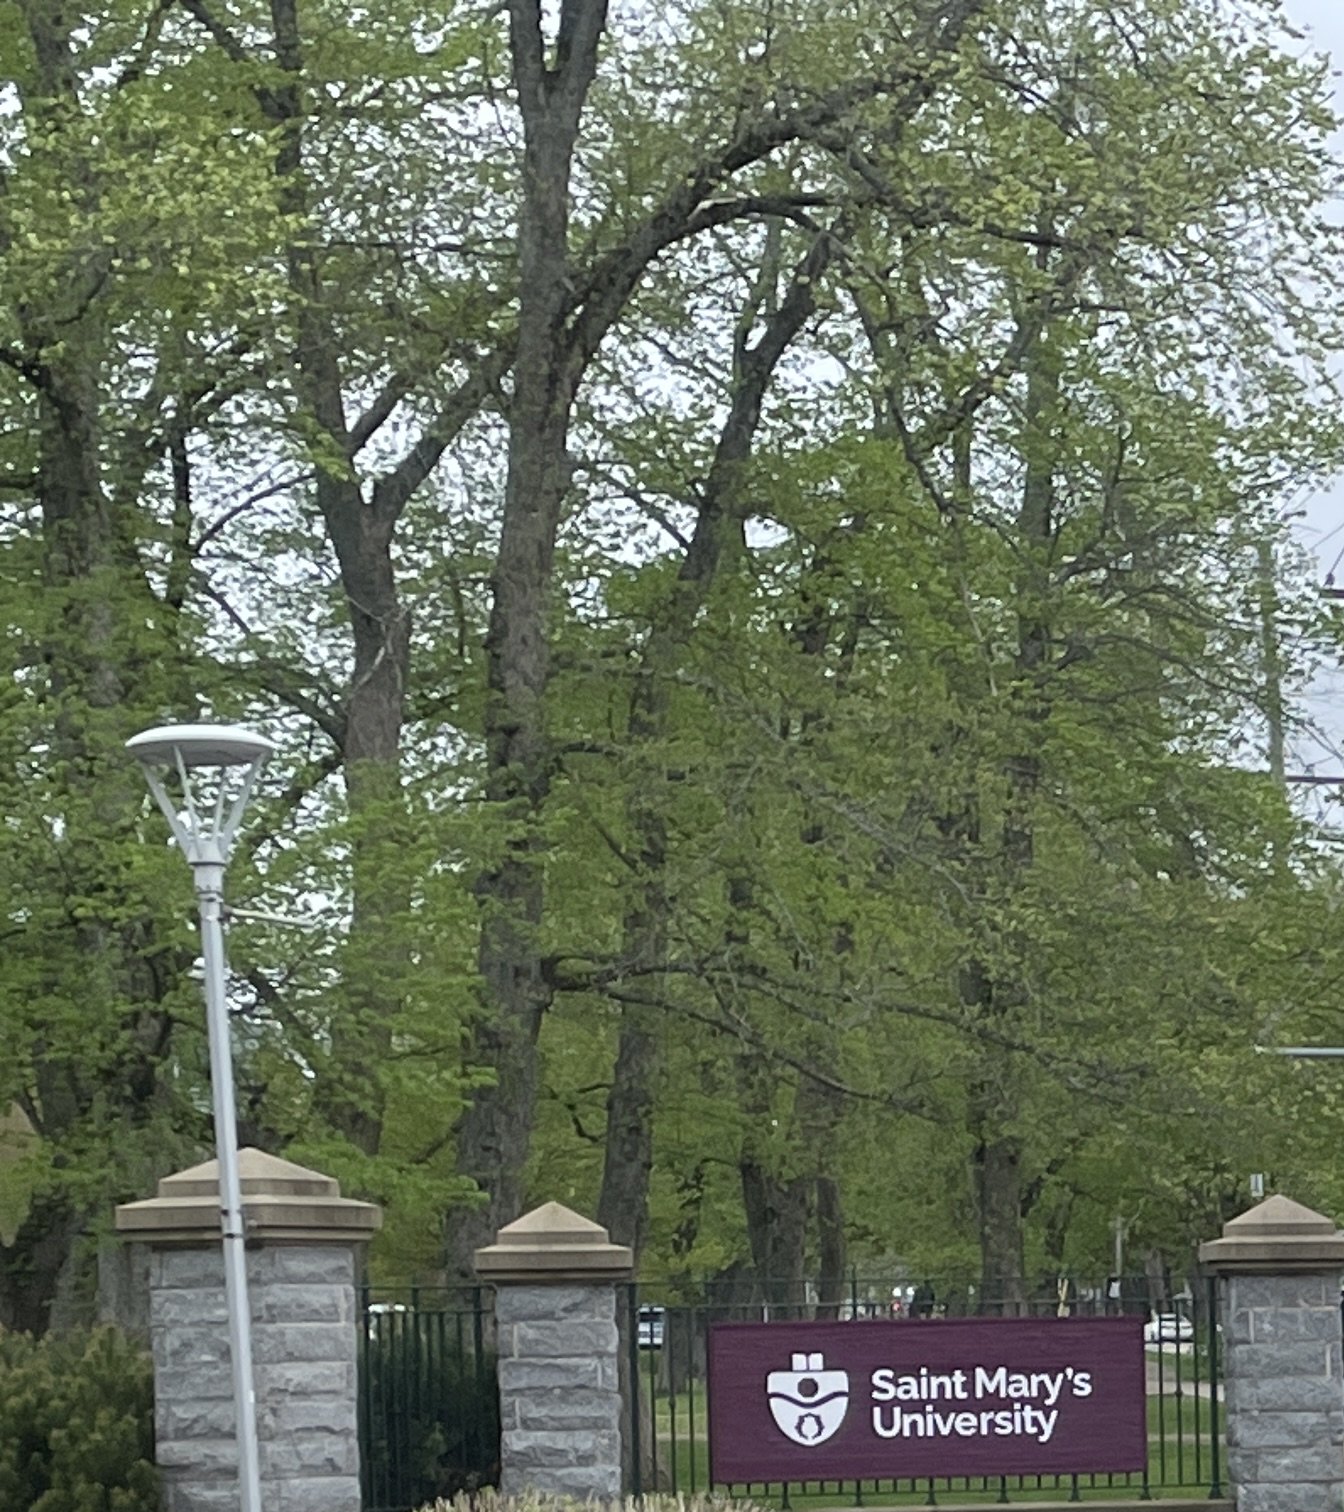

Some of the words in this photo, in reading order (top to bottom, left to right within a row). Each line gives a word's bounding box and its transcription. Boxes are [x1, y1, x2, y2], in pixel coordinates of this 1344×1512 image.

[871, 1367, 968, 1400] Saint
[974, 1366, 1093, 1406] Mary's
[872, 1402, 1059, 1442] University
